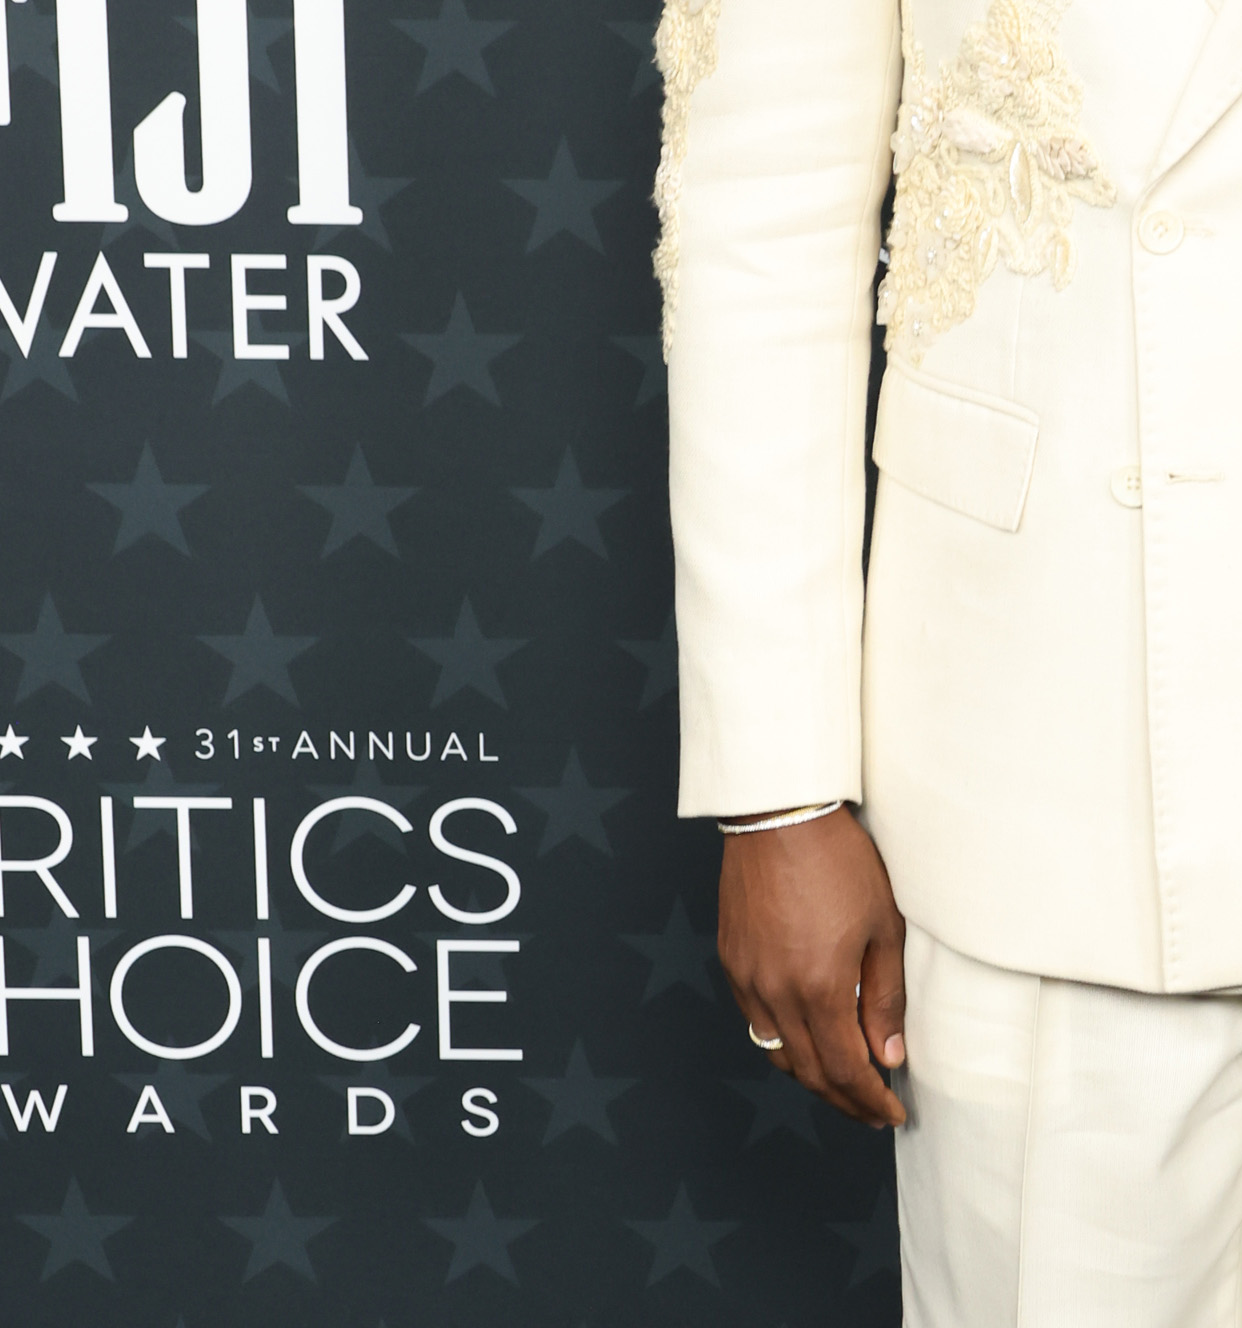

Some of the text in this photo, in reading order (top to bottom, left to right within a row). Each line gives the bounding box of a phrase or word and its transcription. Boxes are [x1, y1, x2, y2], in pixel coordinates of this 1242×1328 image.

[291, 730, 500, 762] ANNUAL
[0, 795, 522, 924] RITICS
[0, 934, 524, 1062] HOICE
[1, 1083, 500, 1137] WARDS
